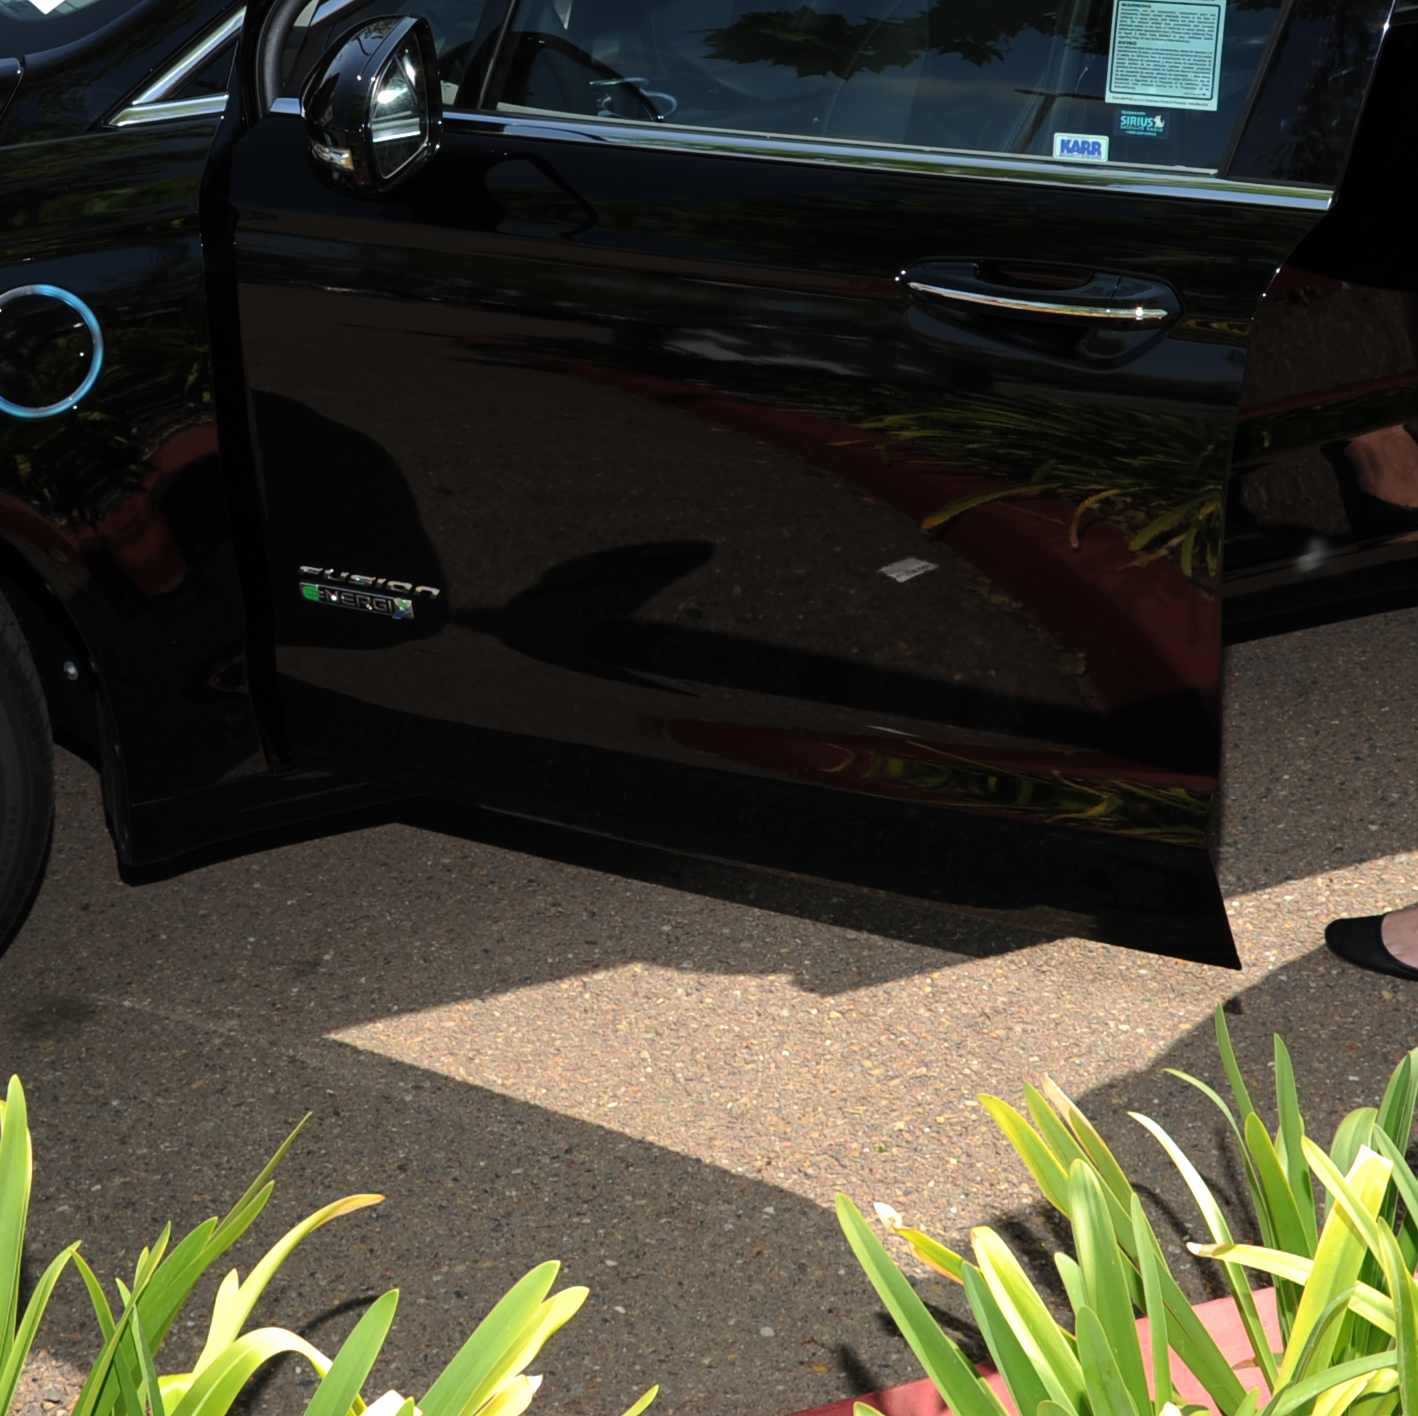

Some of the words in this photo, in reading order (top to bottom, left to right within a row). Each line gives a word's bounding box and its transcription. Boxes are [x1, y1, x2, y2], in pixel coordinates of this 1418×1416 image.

[1120, 115, 1154, 128] SIRIUS
[1060, 138, 1102, 156] KARR
[301, 584, 394, 614] ENERGI
